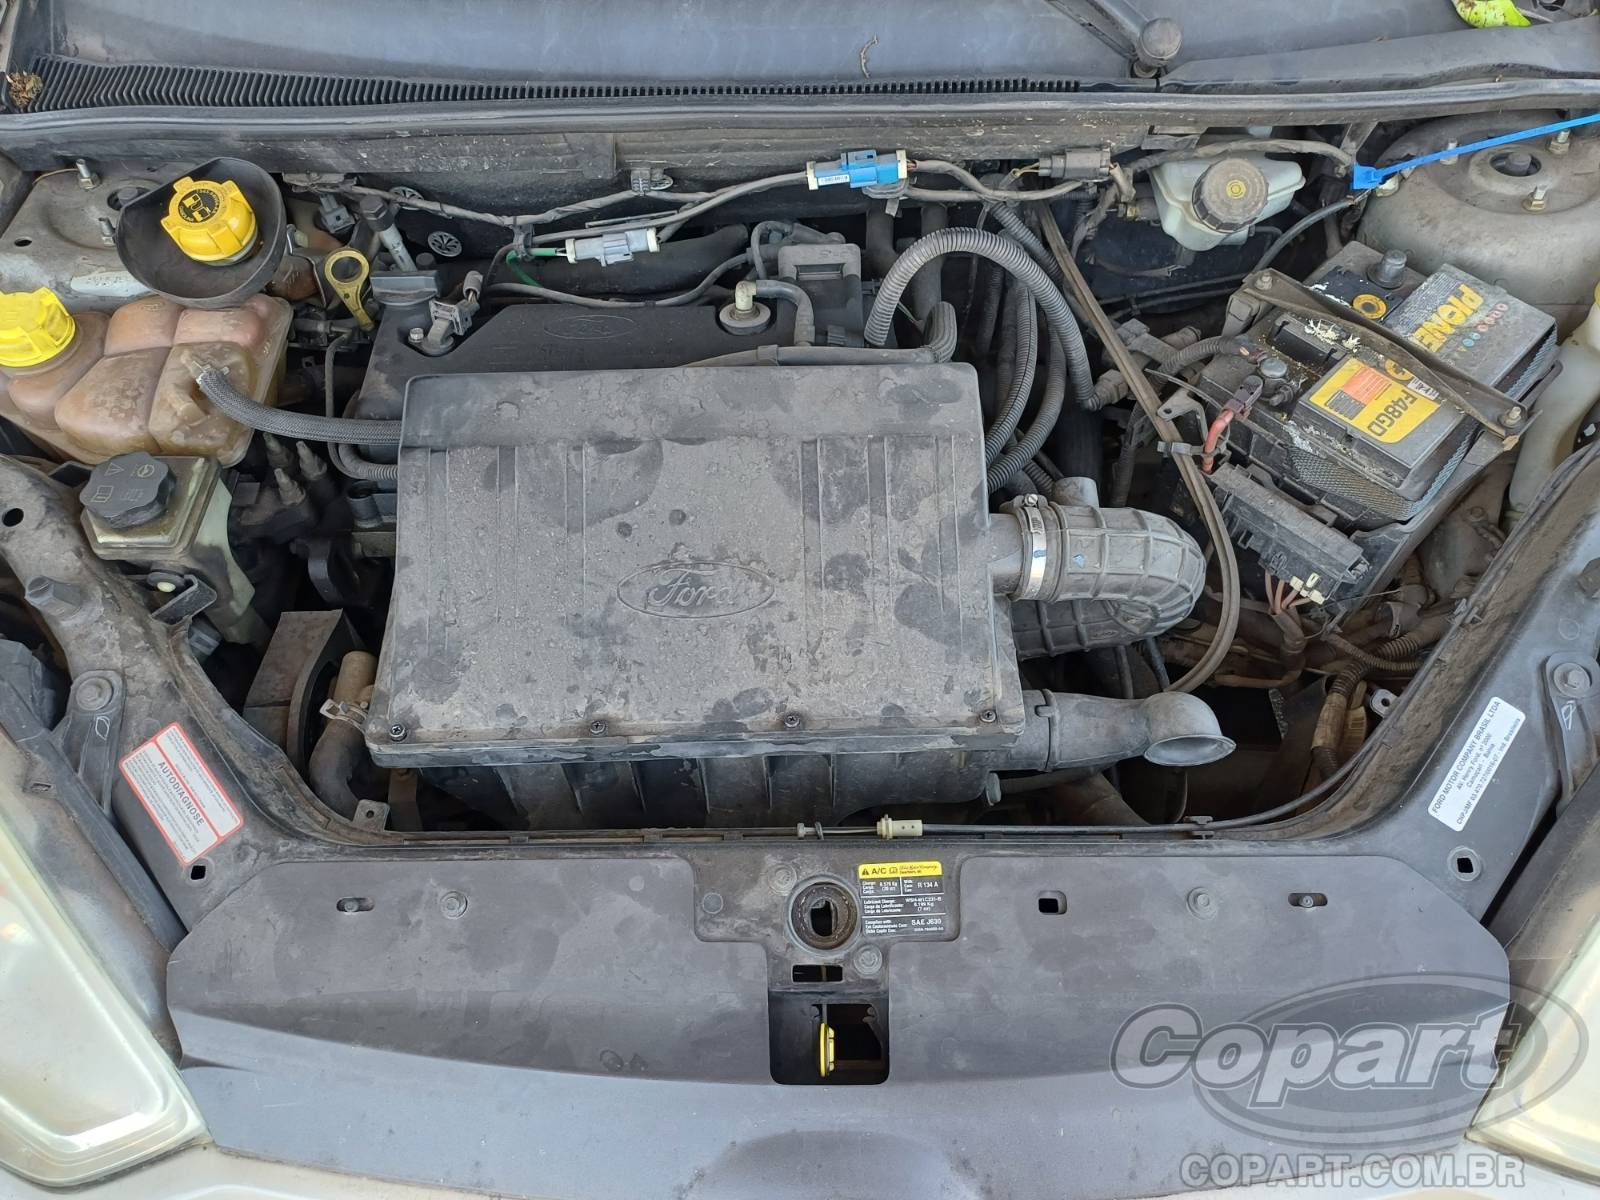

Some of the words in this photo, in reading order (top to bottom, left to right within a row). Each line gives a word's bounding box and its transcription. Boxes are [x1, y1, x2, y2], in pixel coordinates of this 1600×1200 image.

[1368, 389, 1417, 437] F48GD
[648, 568, 738, 606] Ford
[1432, 793, 1446, 813] FORD
[1442, 770, 1460, 795] MOTOR
[1456, 740, 1477, 771] COMPANY
[1473, 717, 1491, 741] BRASIL
[158, 761, 205, 826] AUTODIAGNOSE
